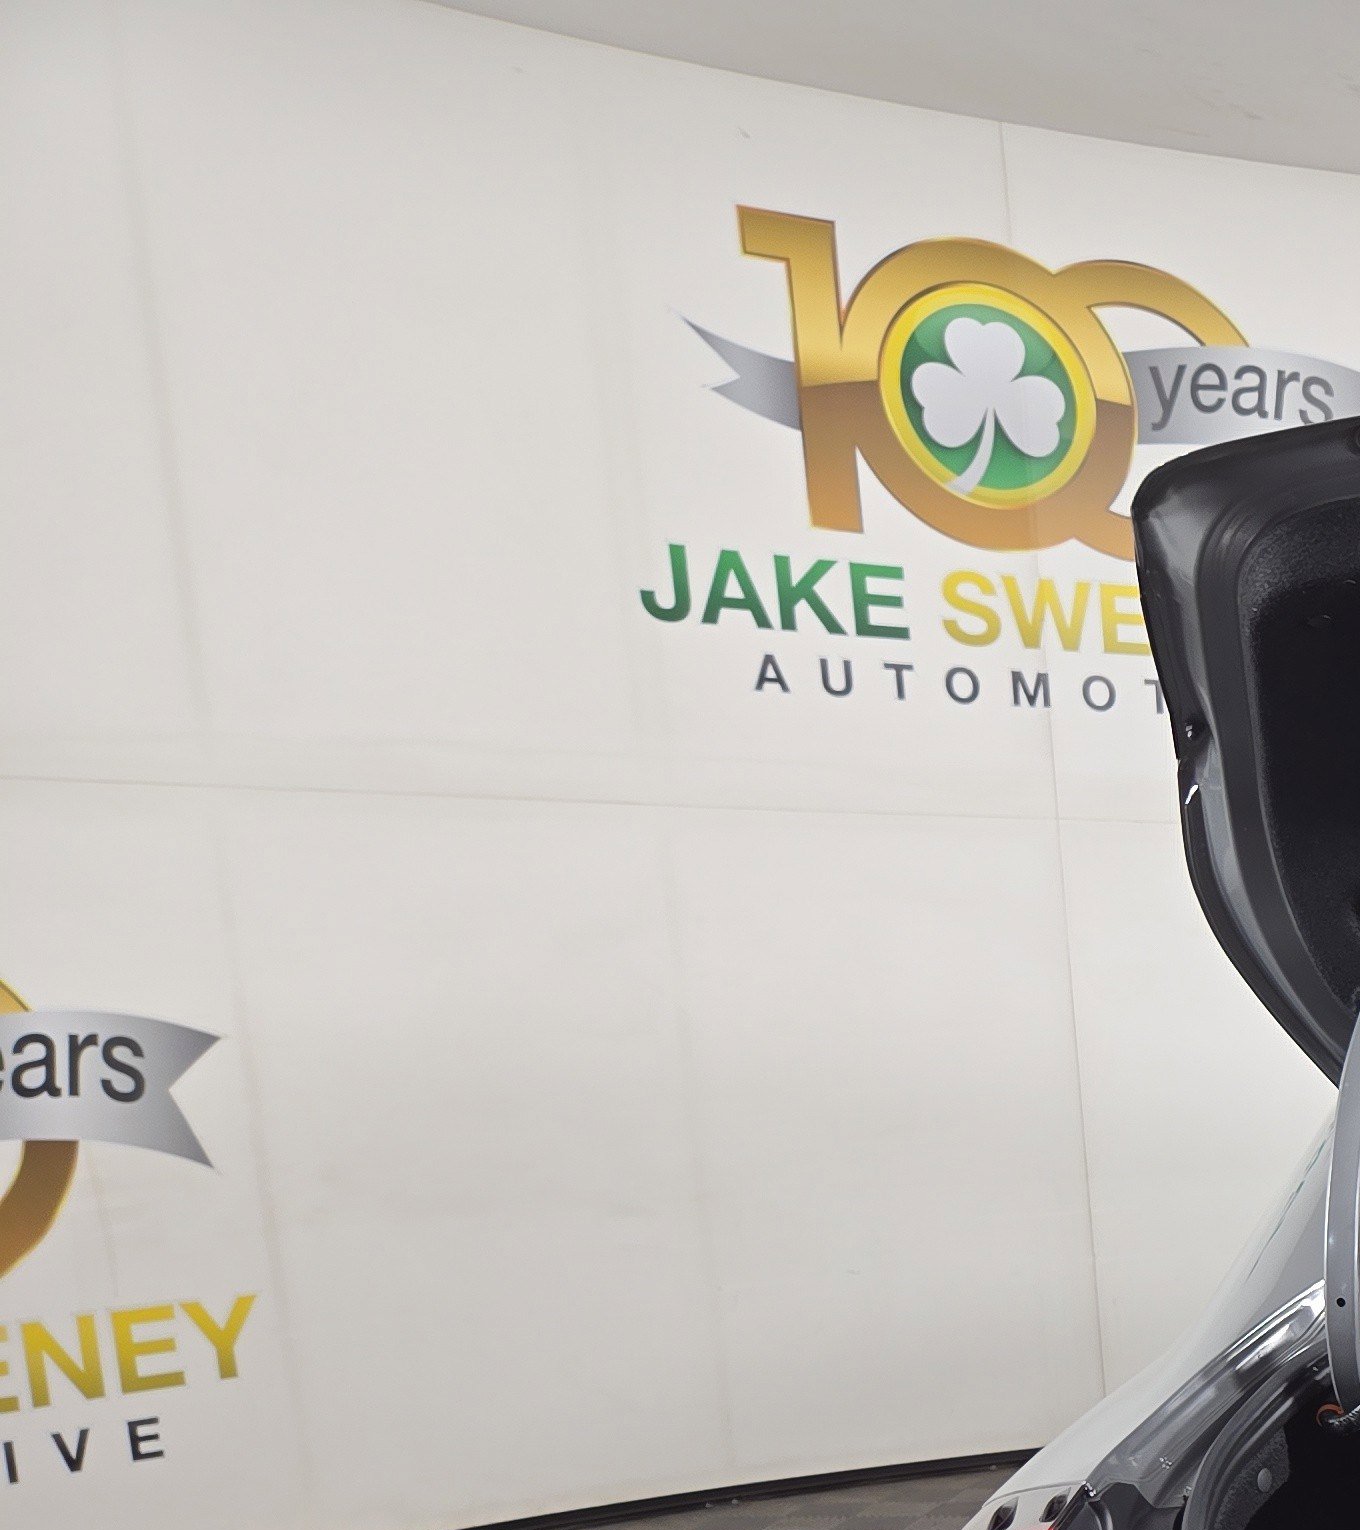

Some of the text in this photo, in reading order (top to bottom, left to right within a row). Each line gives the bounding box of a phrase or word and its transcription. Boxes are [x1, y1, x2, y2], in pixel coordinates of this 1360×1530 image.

[1148, 361, 1335, 432] years
[639, 543, 911, 640] JAKE
[0, 1032, 146, 1103] ars
[0, 1294, 257, 1416] NEY
